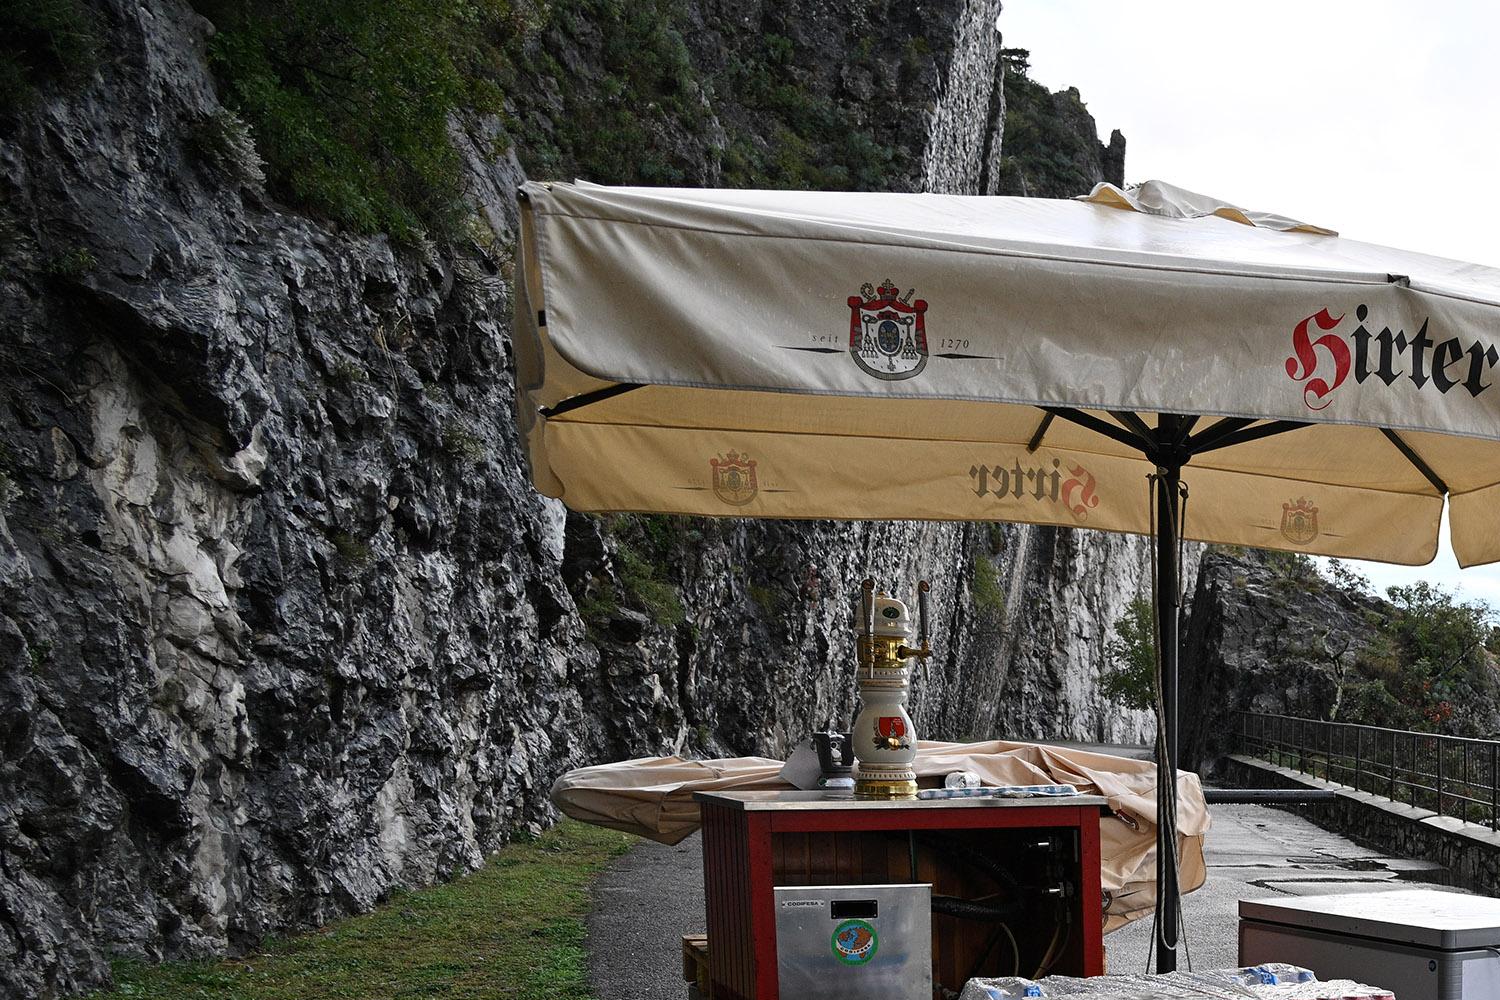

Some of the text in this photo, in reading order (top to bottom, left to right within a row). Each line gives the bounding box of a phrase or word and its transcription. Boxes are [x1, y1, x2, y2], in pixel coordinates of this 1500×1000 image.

[811, 333, 970, 350] seit 1270
[1284, 303, 1500, 411] Hirter
